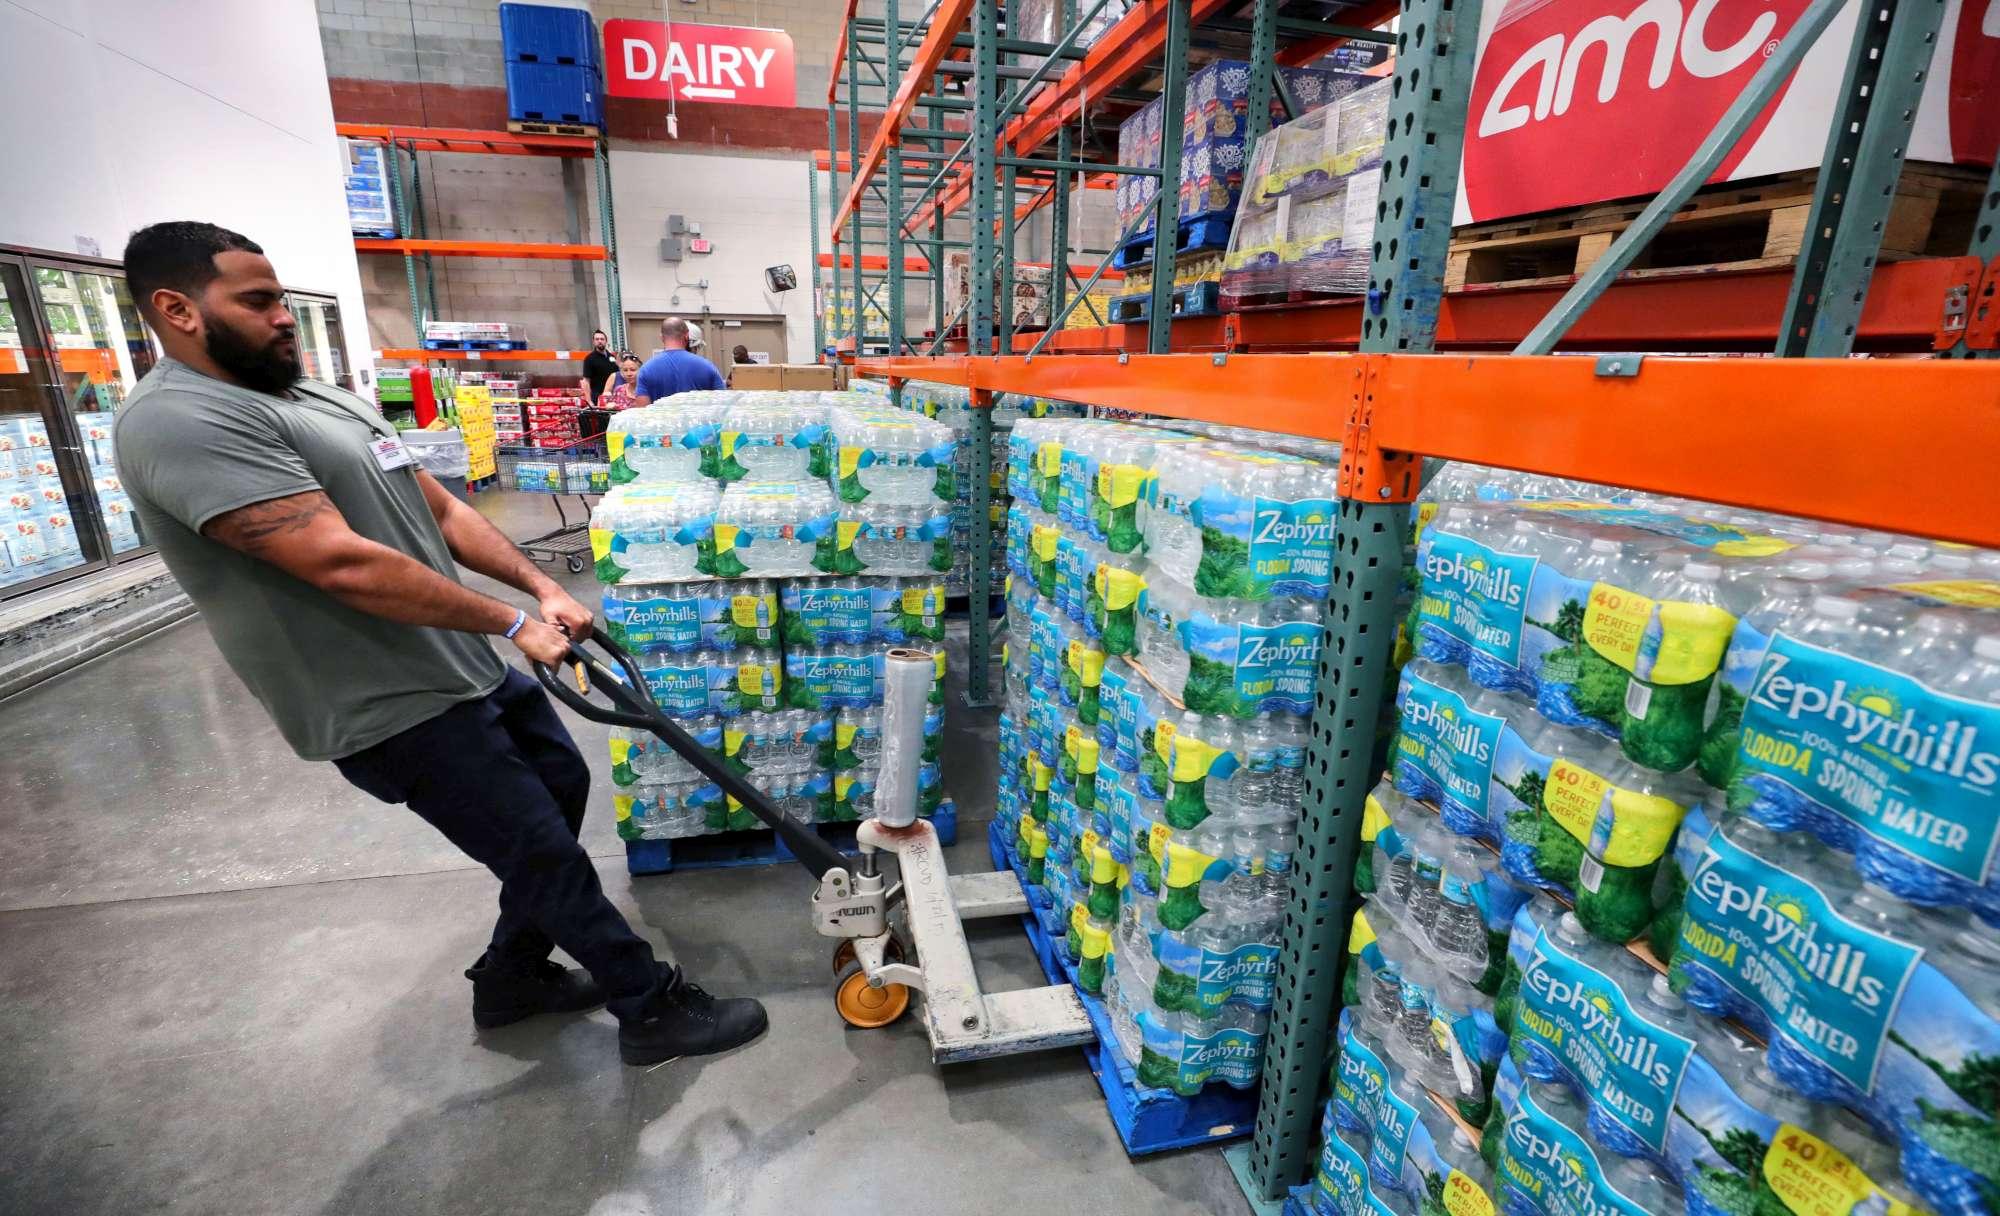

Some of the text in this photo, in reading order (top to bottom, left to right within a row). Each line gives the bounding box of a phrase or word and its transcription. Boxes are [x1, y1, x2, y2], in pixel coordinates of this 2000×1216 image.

[622, 38, 776, 89] DAIRY
[1253, 510, 1338, 545] Zephyrh
[1291, 559, 1329, 576] SPRING
[1425, 541, 1521, 605] ephyrhills
[801, 594, 869, 612] Zephyrhills
[1594, 592, 1621, 610] 40
[625, 606, 698, 626] Zephyrhills
[1238, 635, 1322, 668] Zephyrh
[1589, 633, 1618, 649] EVERY
[643, 672, 705, 691] ephyrhills
[806, 661, 872, 679] Zephyrhills
[1275, 678, 1311, 695] SPRING
[1403, 683, 1490, 763] ephyrhills
[1750, 653, 2000, 786] Zephyrhills
[1555, 768, 1580, 786] 40
[1550, 803, 1576, 820] EVERY
[1817, 758, 1883, 816] SPRING
[1881, 798, 1969, 853] WATER
[838, 905, 876, 917] ROWN
[1691, 846, 1886, 1006] Zephyrhills
[1201, 955, 1276, 982] Zephyrh
[1525, 948, 1672, 1087] Zephyrhills
[1741, 955, 1790, 1015] SPRING
[1788, 1004, 1859, 1061] WATER
[1183, 1041, 1260, 1065] Zephyrhi
[1565, 1038, 1604, 1089] SPRING
[1601, 1079, 1655, 1127] WATER
[1508, 1100, 1629, 1216] Zephyrhi
[1782, 1135, 1816, 1160] 40
[1451, 1177, 1472, 1194] 40
[1504, 1154, 1542, 1197] LORIDA
